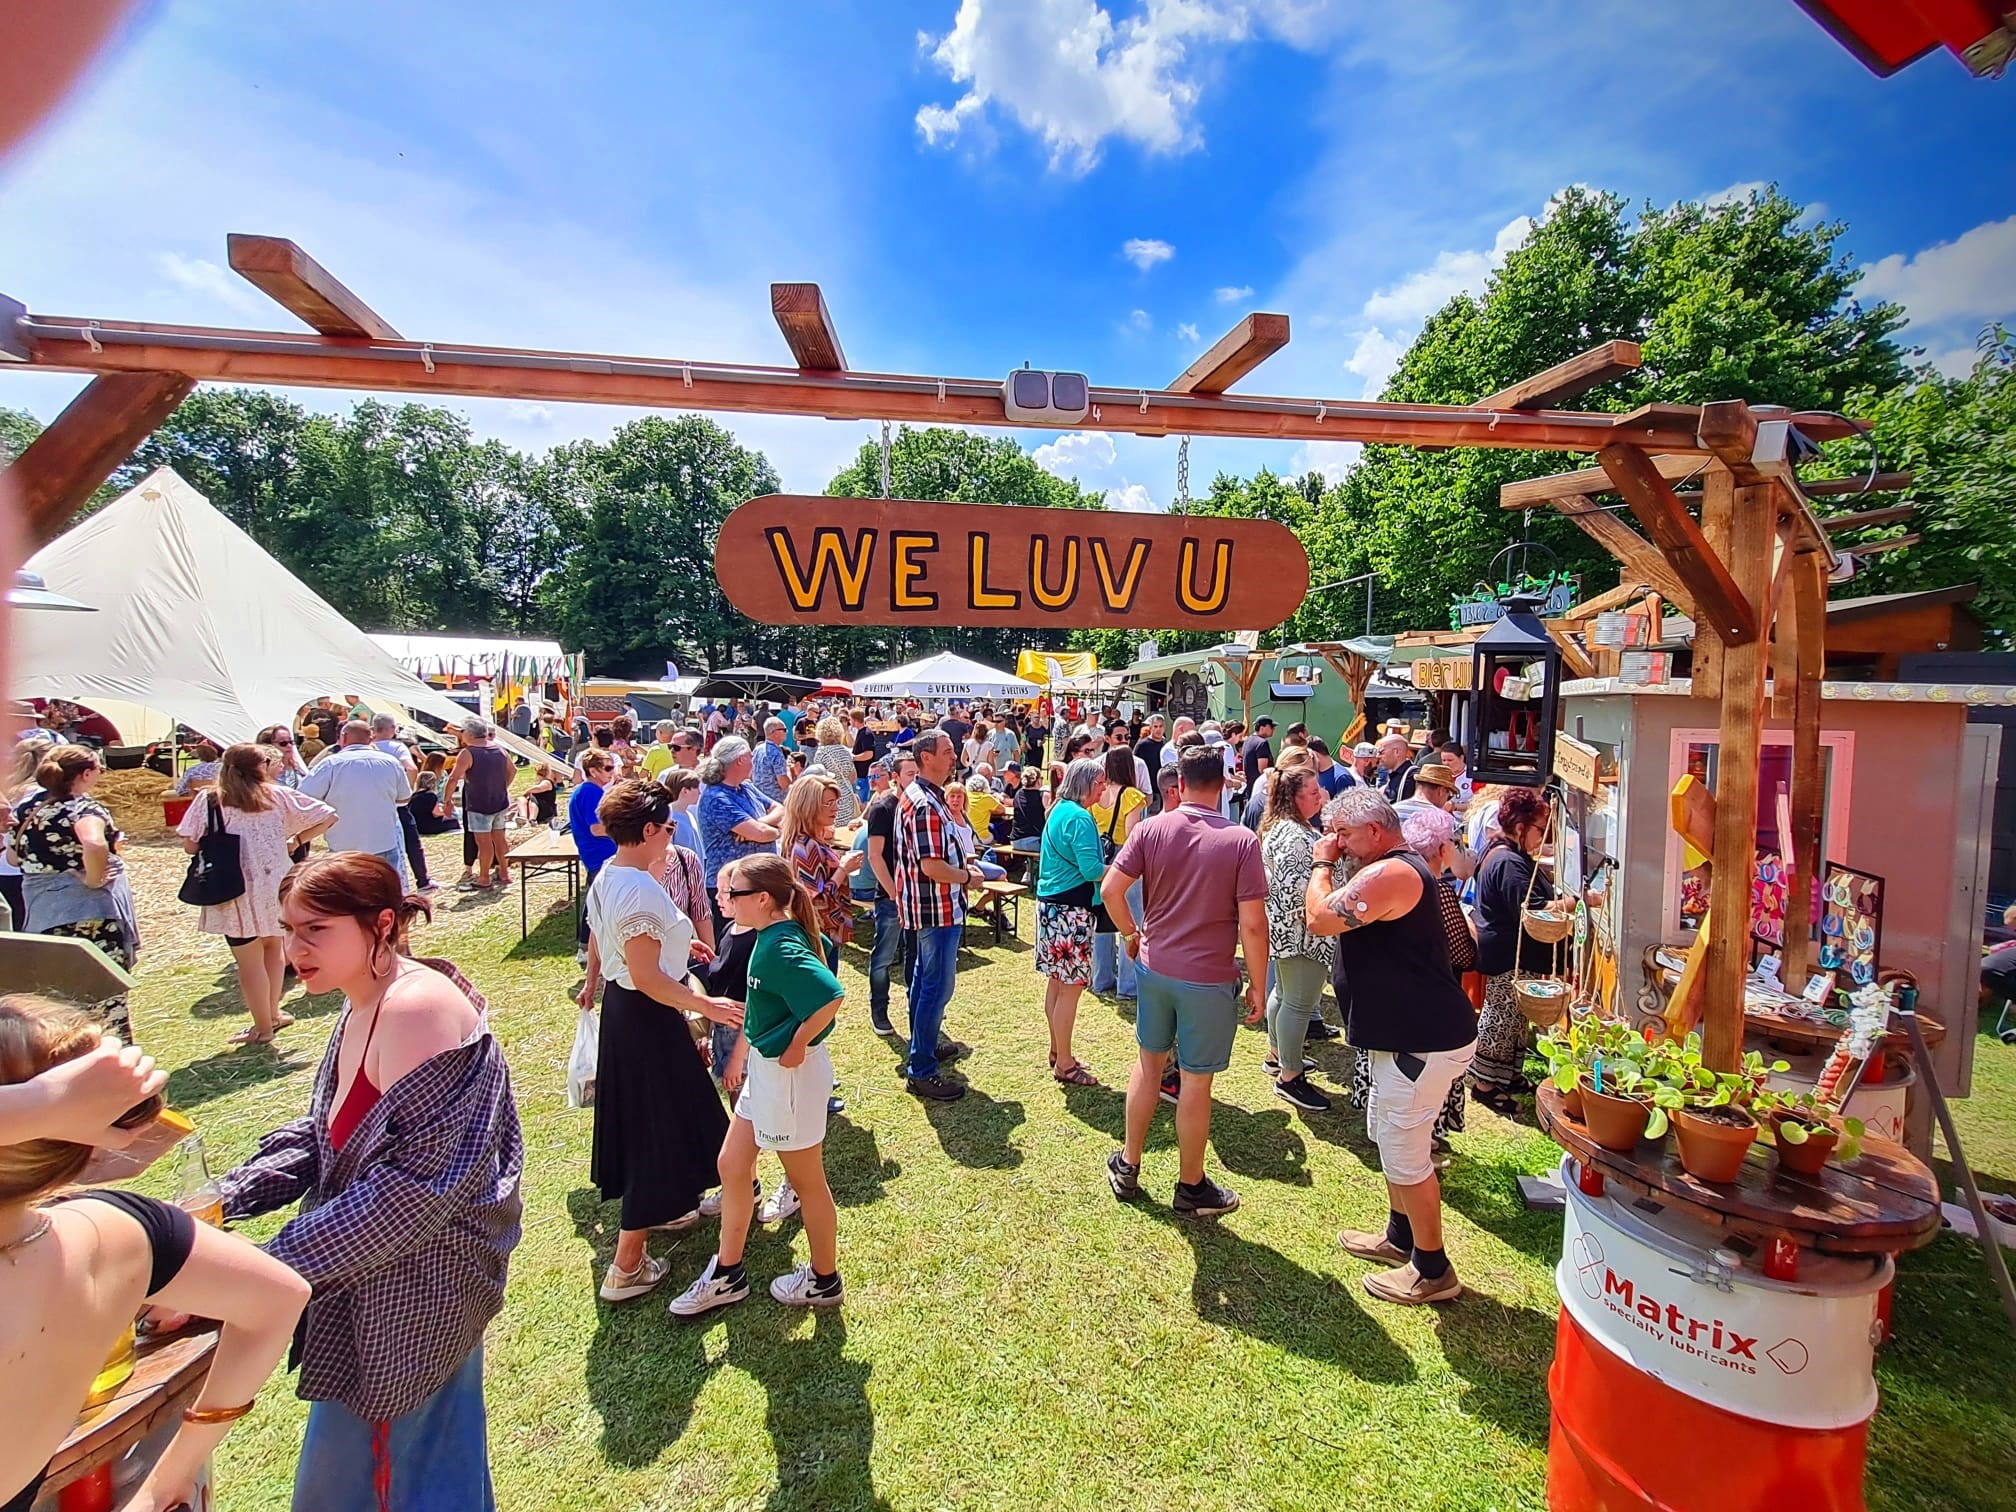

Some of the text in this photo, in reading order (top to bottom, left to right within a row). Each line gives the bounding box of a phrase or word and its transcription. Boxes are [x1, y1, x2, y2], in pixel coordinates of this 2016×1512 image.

[765, 526, 1234, 615] WE LUV U
[868, 684, 894, 693] VELTINS
[935, 684, 971, 694] VELTINS
[1006, 686, 1029, 695] VELTINS
[1604, 1267, 1758, 1361] Matrix
[1604, 1298, 1757, 1375] specialty lubricants
